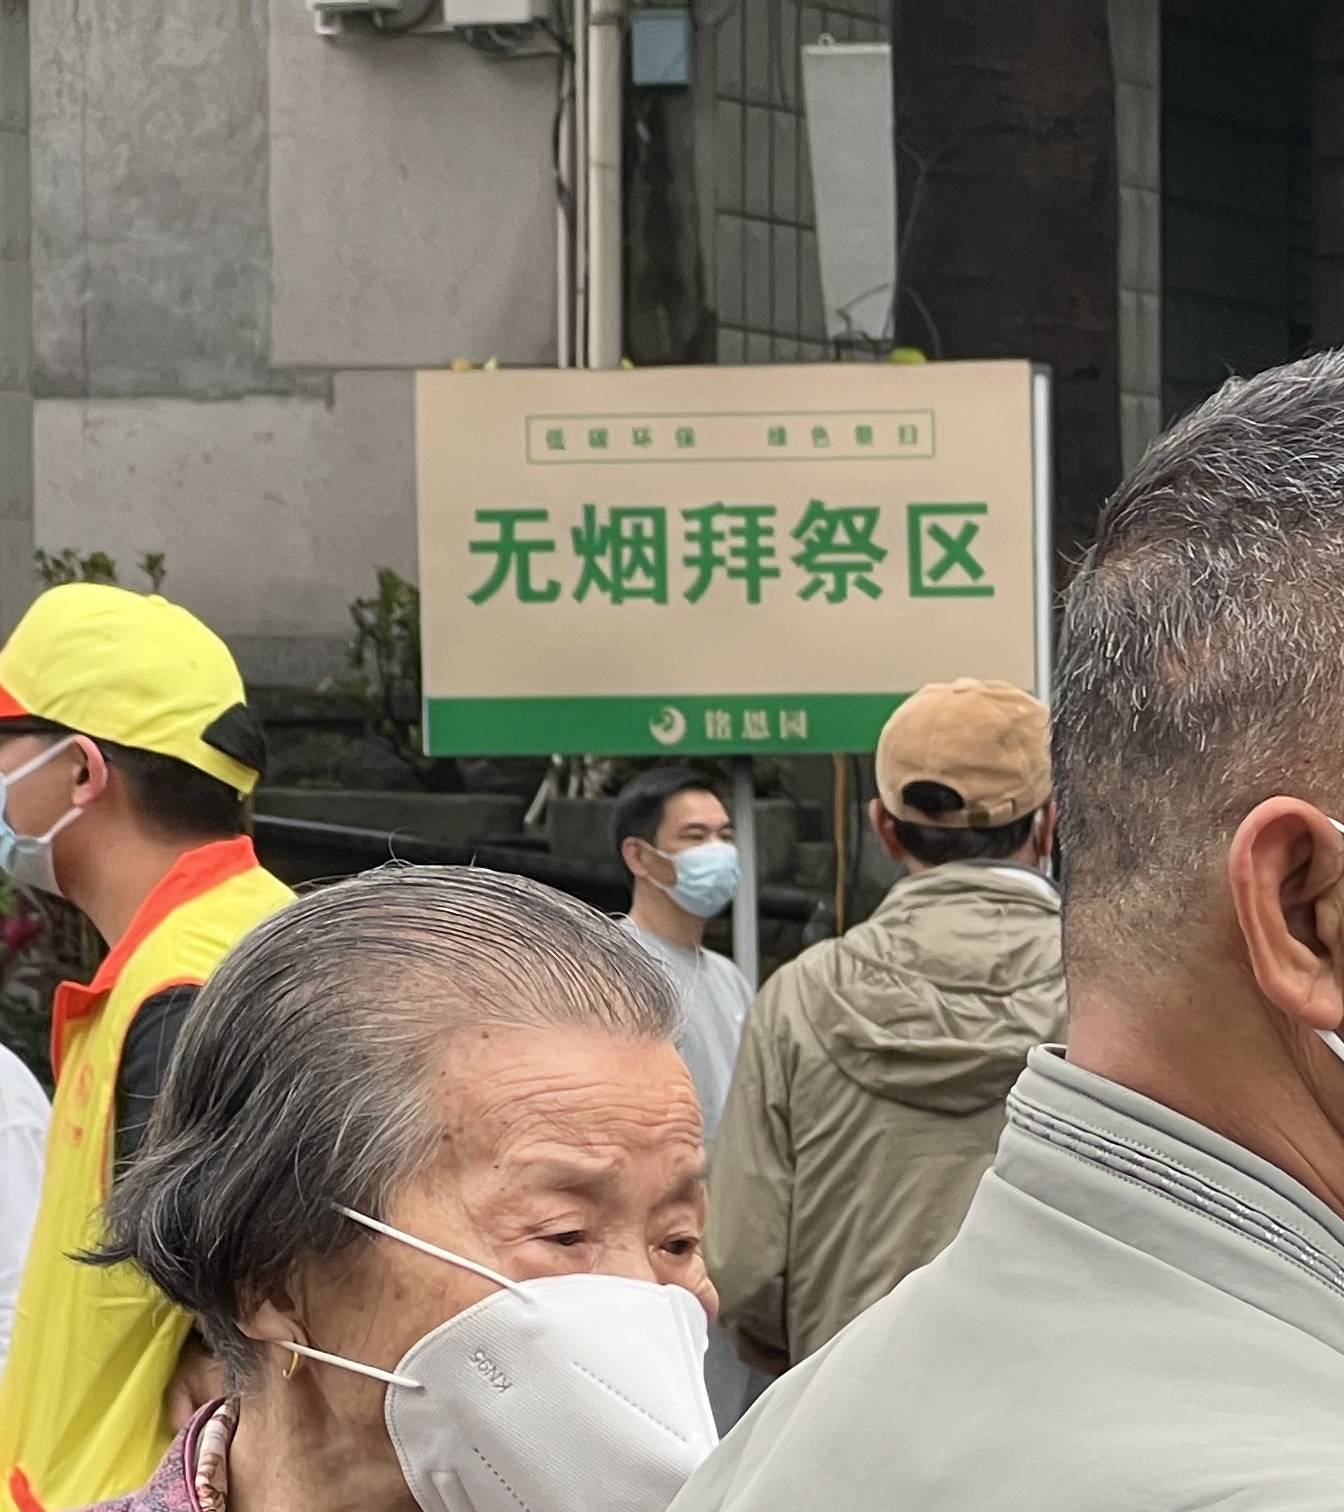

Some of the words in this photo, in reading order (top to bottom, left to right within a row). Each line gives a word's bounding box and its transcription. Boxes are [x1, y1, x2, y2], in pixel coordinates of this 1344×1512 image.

[466, 499, 996, 607] 无烟拜祭区
[469, 1350, 512, 1393] KN95
